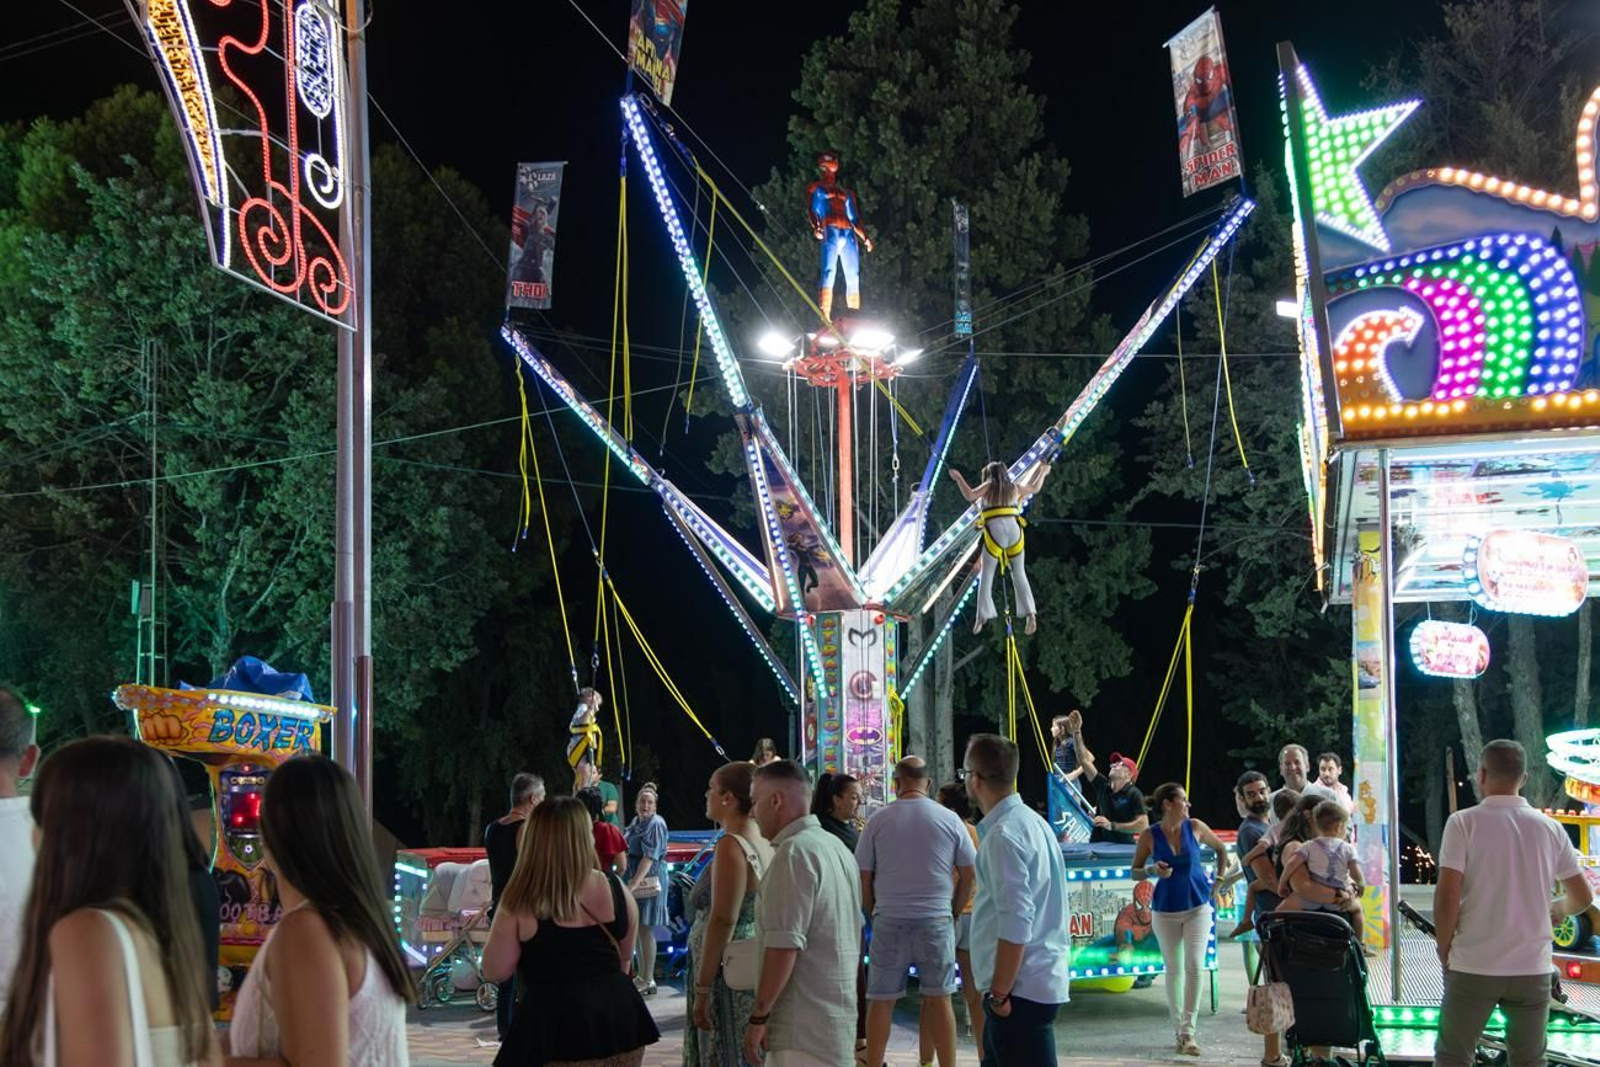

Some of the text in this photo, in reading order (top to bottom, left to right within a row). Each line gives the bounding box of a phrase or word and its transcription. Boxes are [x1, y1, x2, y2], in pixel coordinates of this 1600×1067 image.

[1185, 142, 1235, 173] SPIDER
[1192, 160, 1232, 187] MAN
[208, 708, 314, 754] BOXER
